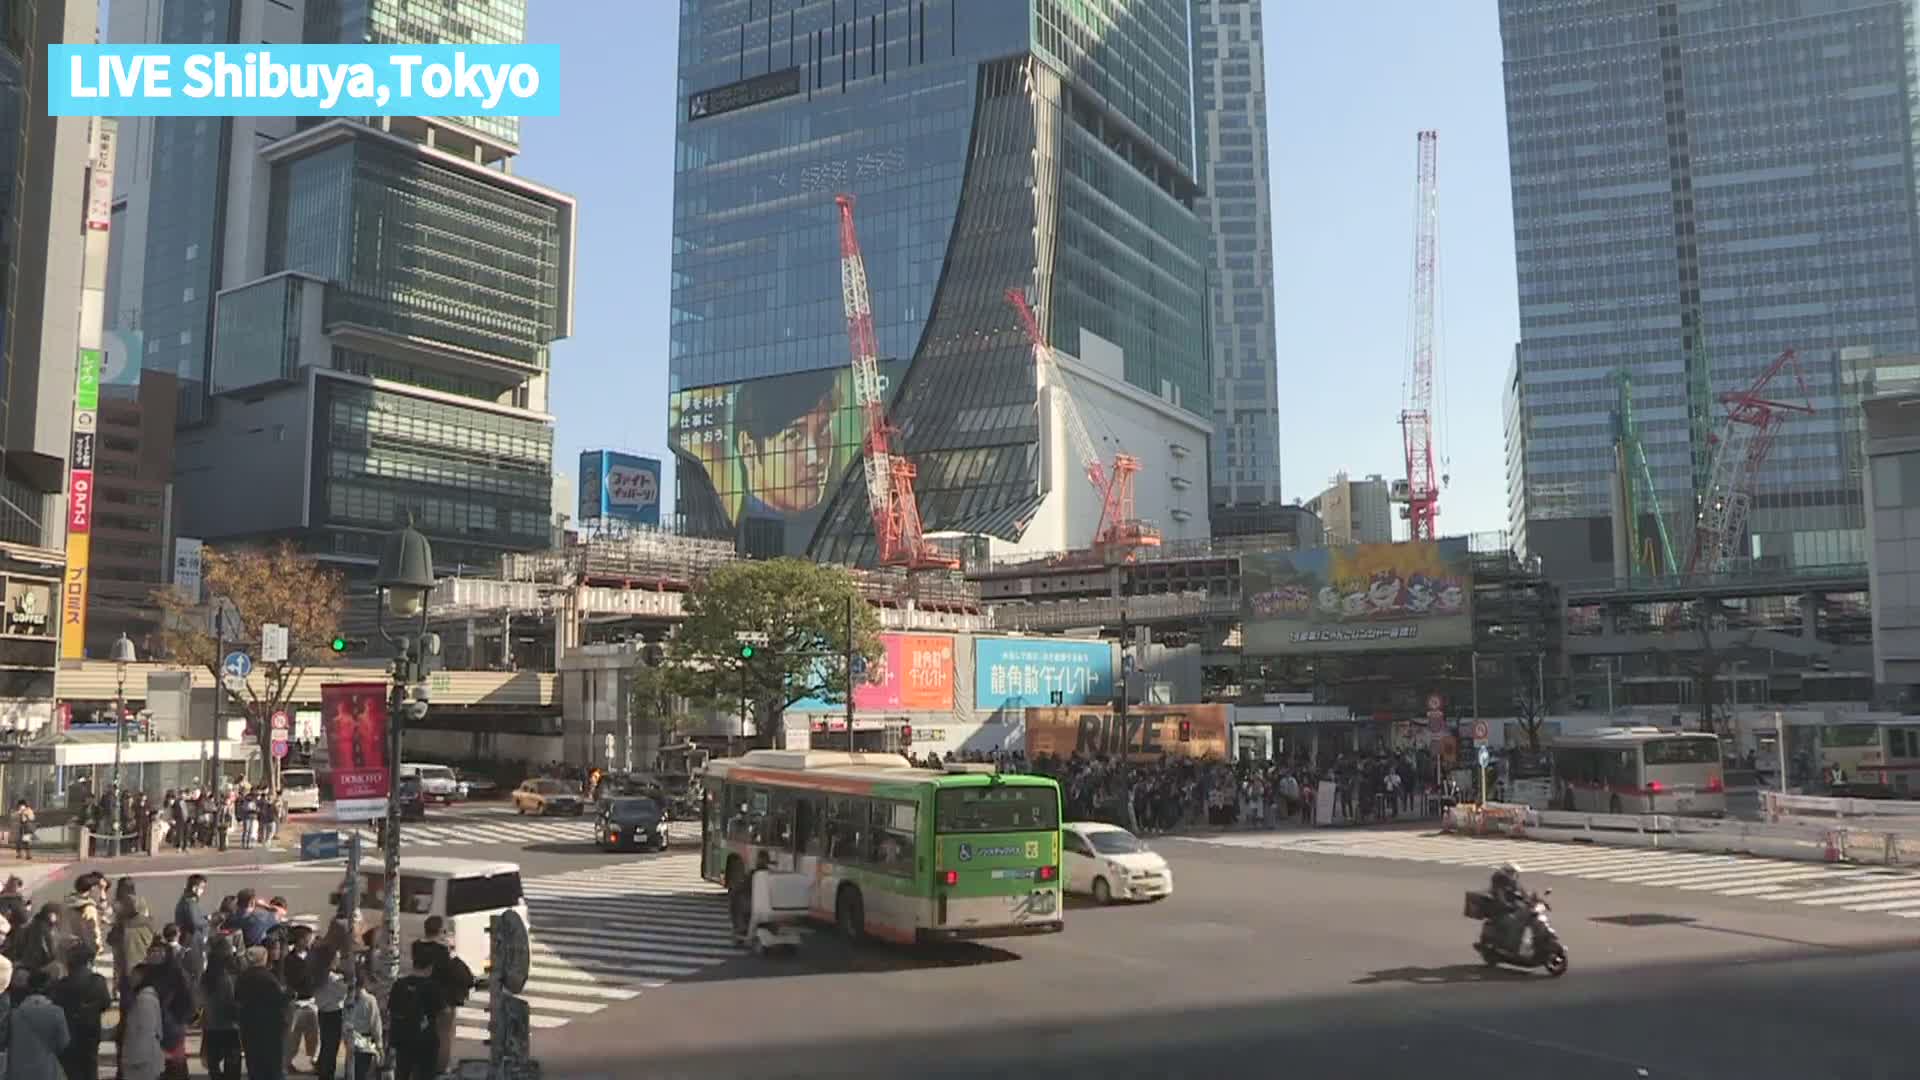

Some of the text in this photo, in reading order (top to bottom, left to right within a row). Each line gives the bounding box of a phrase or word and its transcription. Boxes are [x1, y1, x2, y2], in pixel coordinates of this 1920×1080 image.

[680, 414, 713, 429] 仕事に
[67, 567, 84, 624] プロミス
[12, 612, 45, 625] COFFEE
[991, 663, 1100, 696] 龍角散ダイレクト
